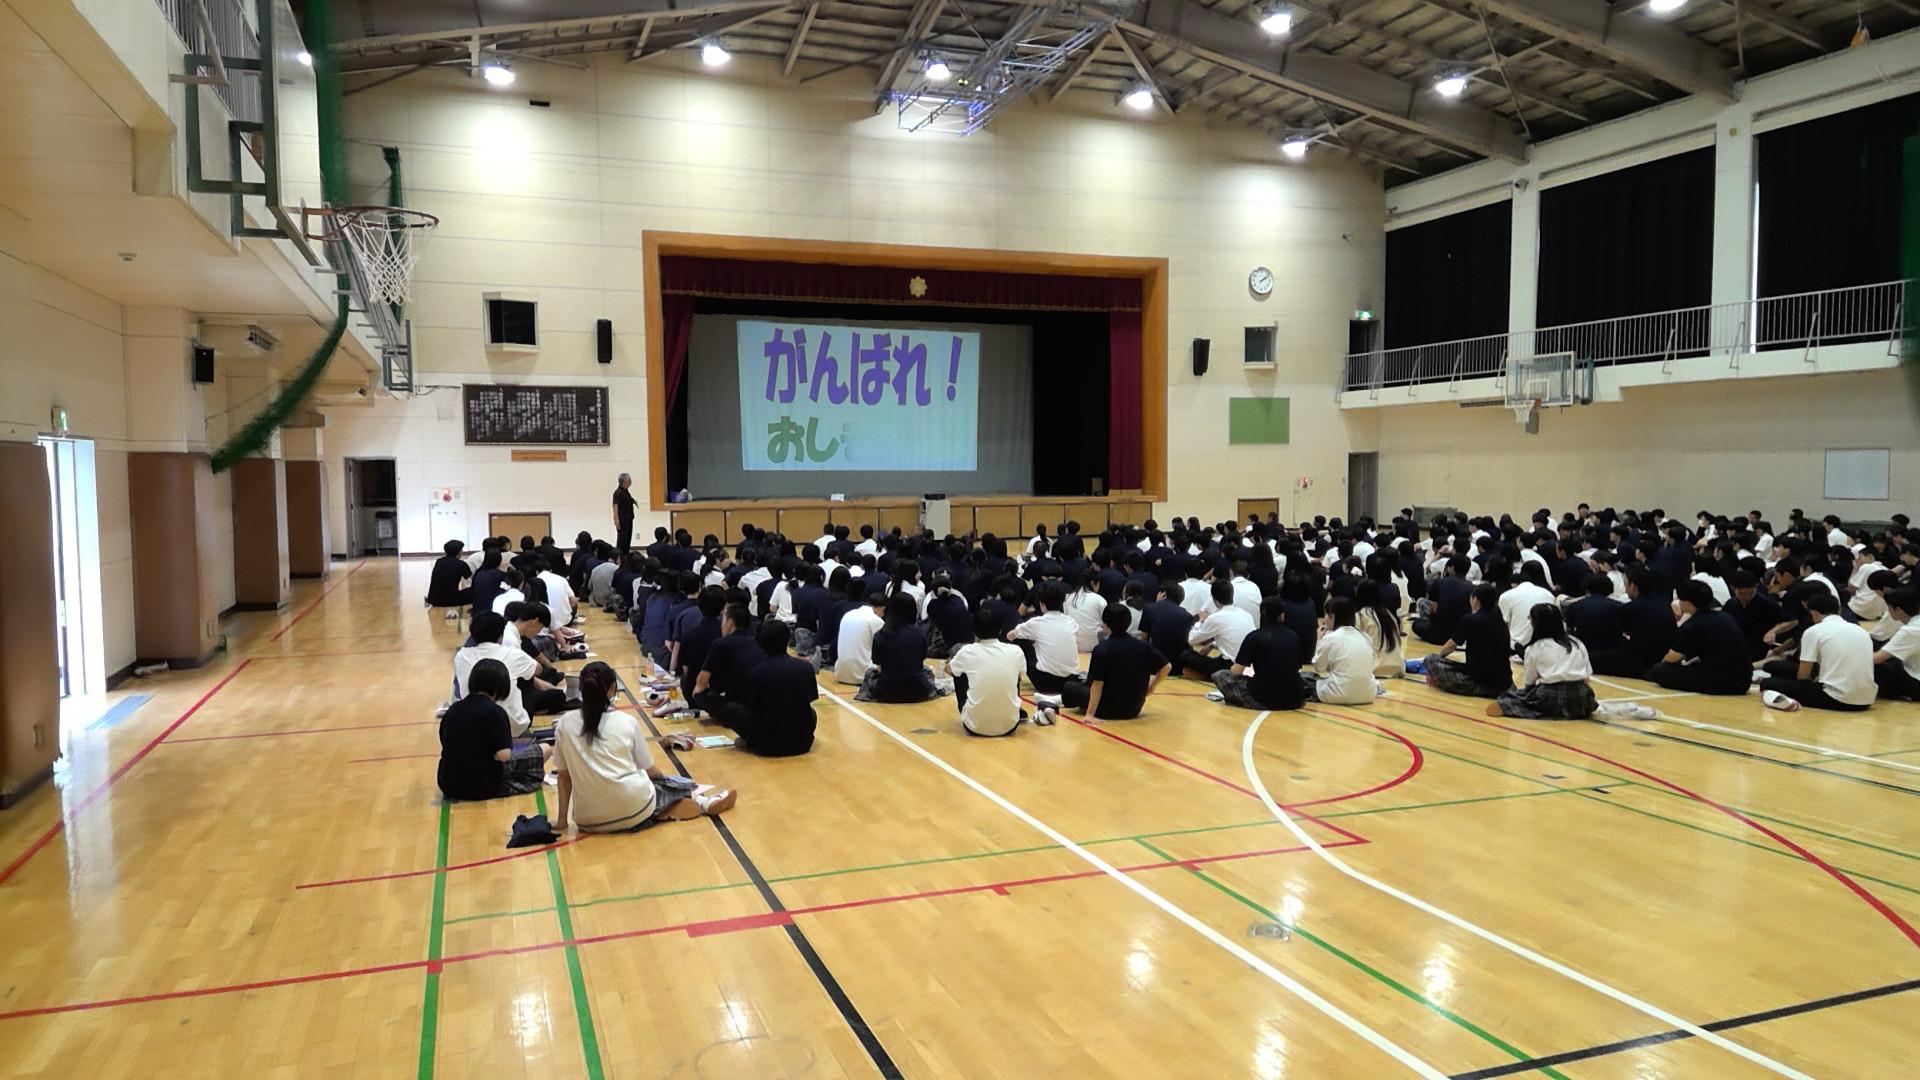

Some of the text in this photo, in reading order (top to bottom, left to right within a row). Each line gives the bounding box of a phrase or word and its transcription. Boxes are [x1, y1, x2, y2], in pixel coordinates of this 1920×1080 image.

[764, 328, 962, 406] がんばれ！
[767, 415, 854, 464] おし
